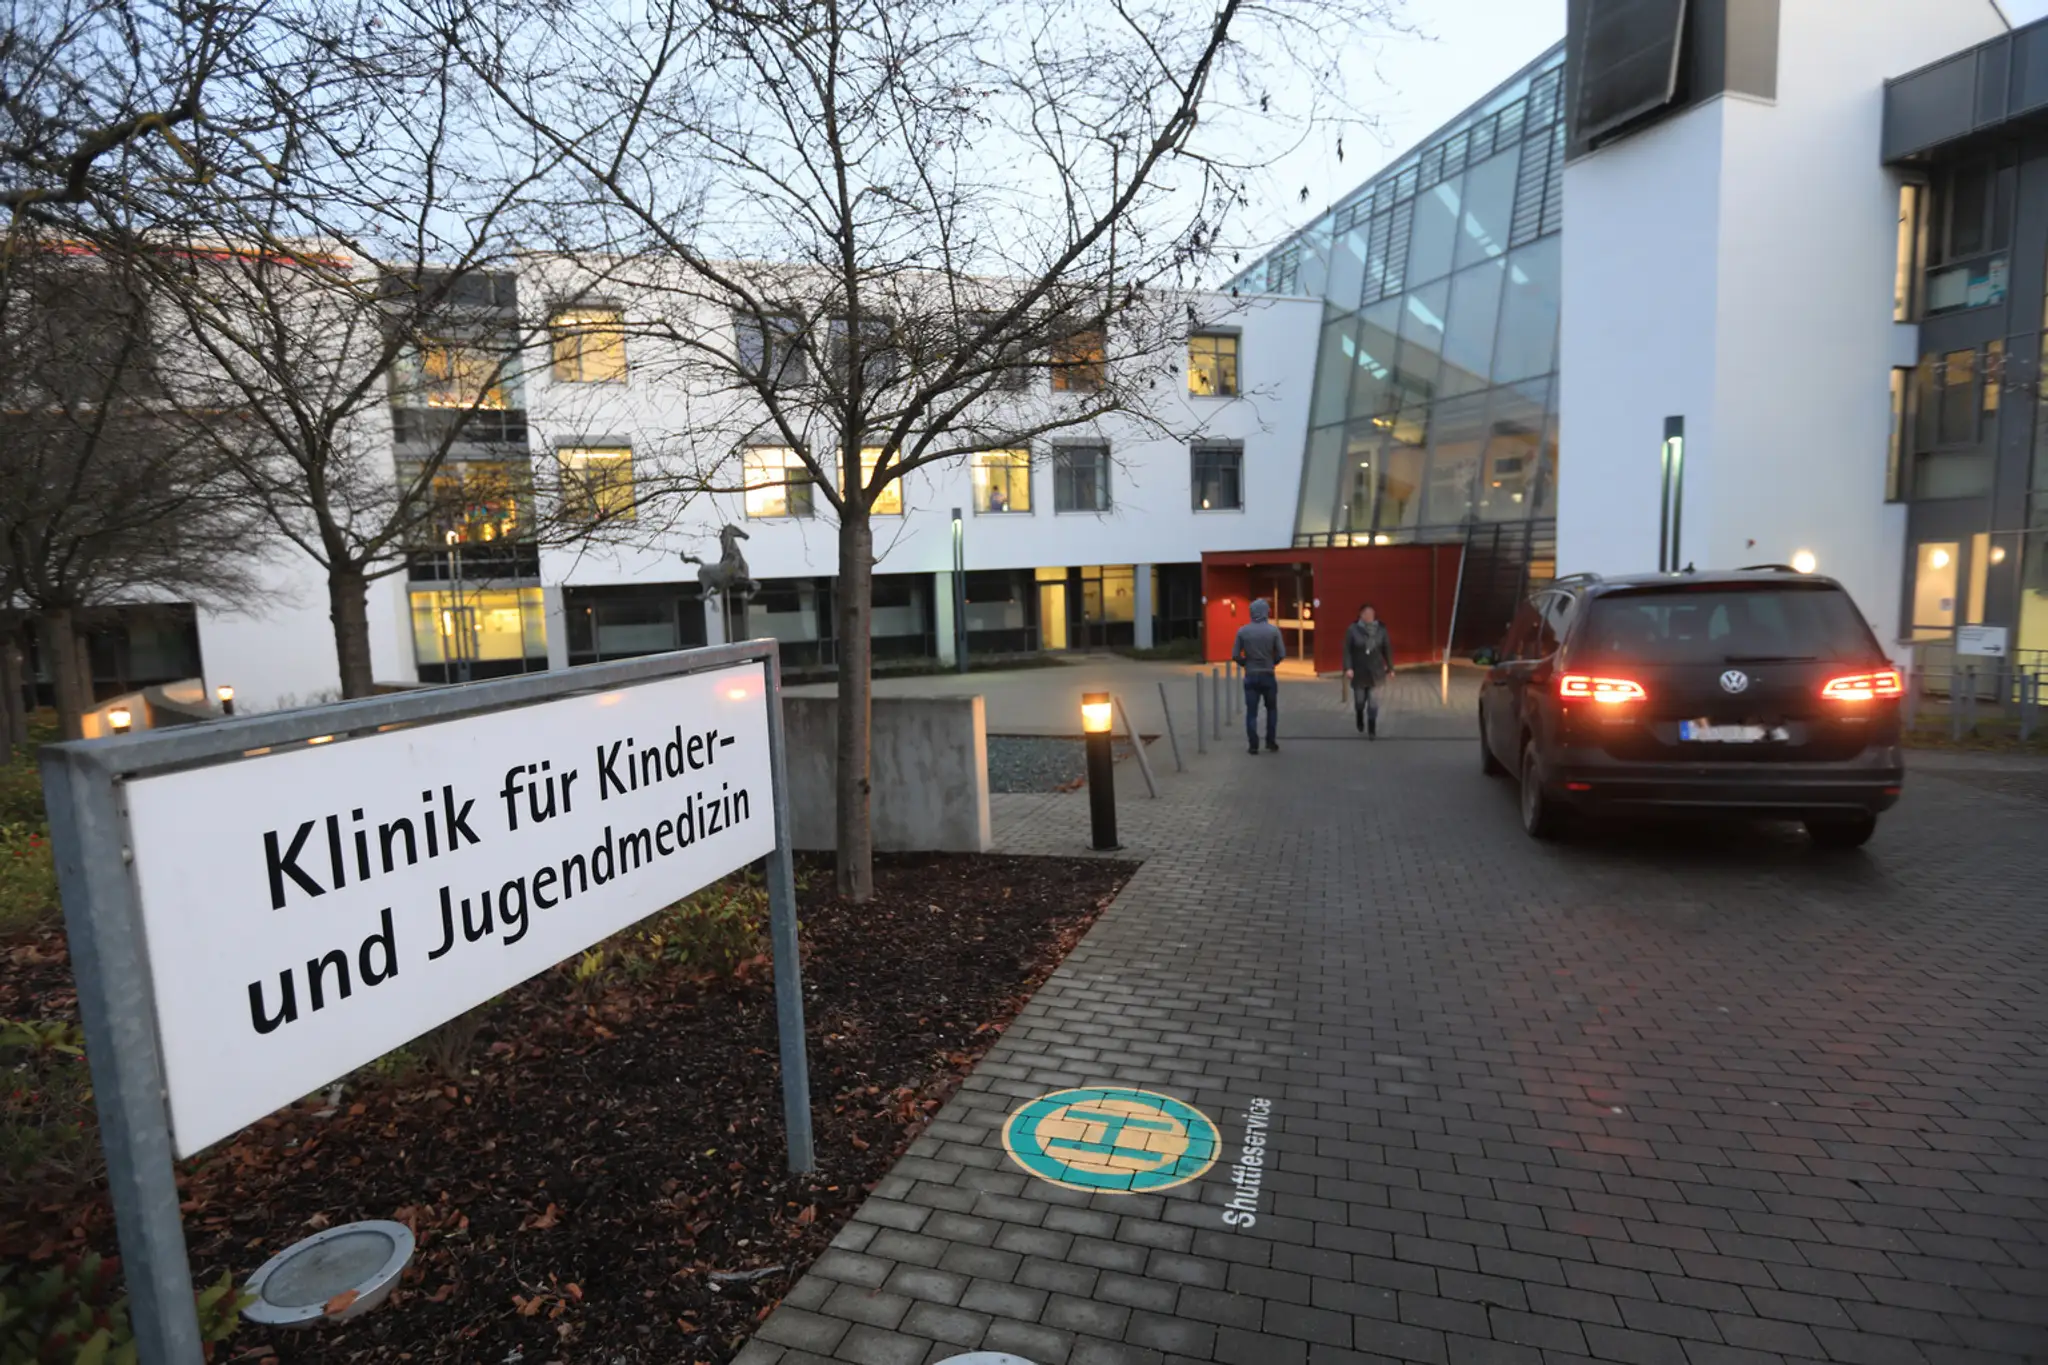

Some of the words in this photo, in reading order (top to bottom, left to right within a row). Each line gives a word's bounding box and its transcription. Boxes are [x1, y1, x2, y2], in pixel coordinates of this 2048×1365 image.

[247, 907, 399, 1035] und
[427, 781, 750, 961] Jugendmedizin
[263, 784, 481, 911] Klinik
[499, 759, 578, 832] für
[596, 725, 735, 801] Kinder-
[1222, 1097, 1272, 1228] Shuttleservice
